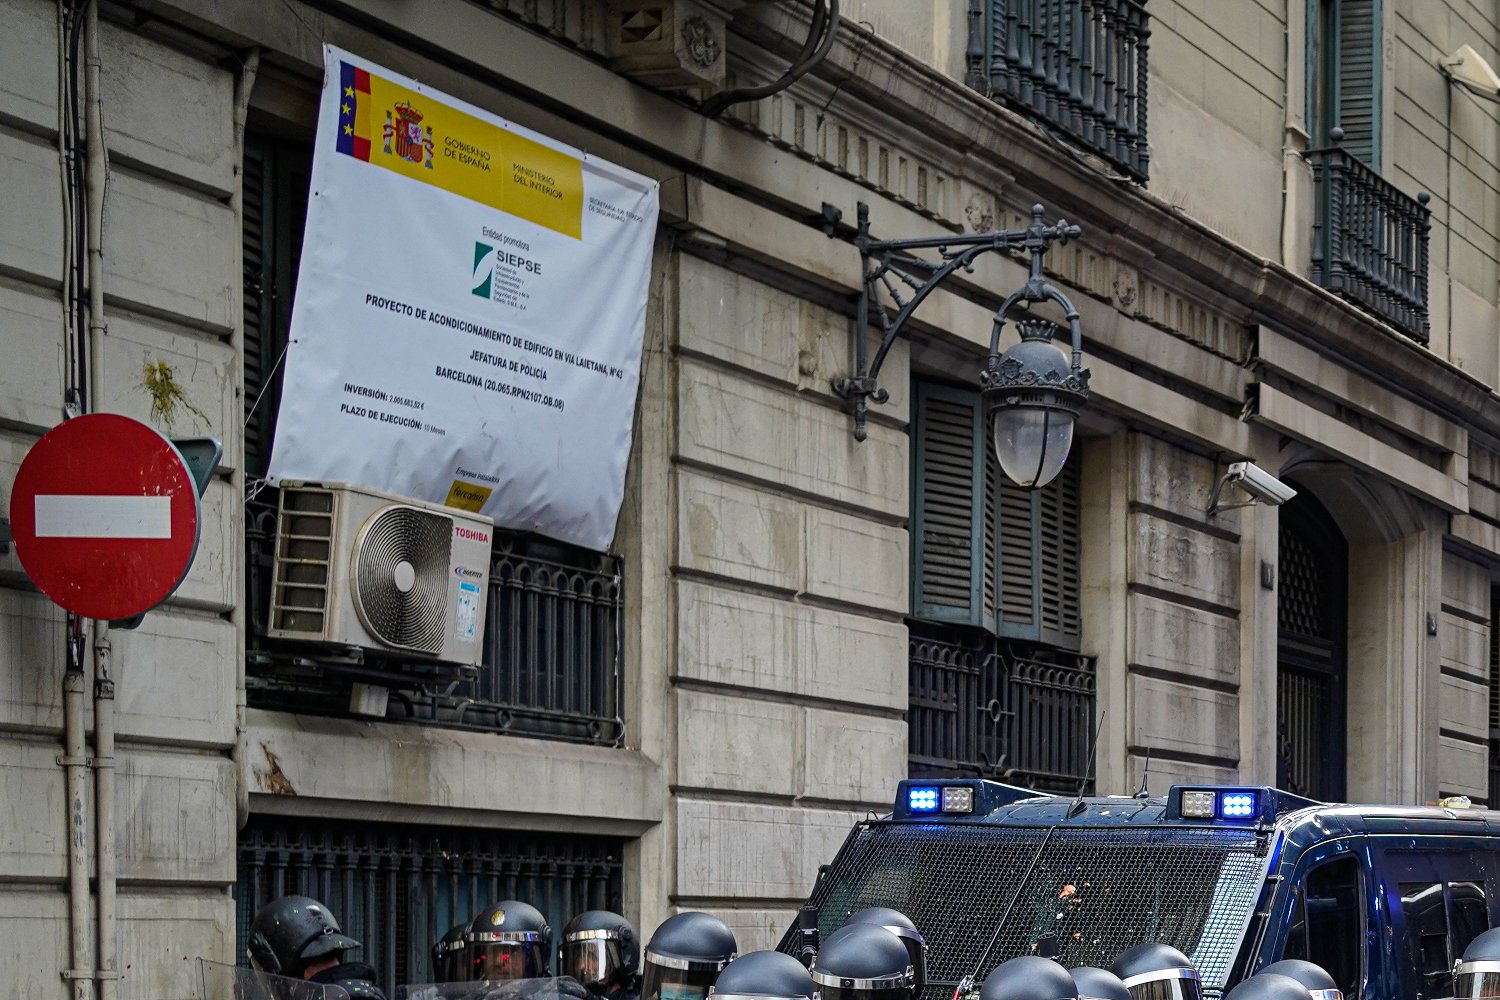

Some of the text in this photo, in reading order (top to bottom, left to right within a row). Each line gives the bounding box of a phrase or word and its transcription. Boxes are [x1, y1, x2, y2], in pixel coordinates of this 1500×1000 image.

[444, 149, 490, 173] DE ESPAÑA
[445, 136, 490, 161] GOBIERNO
[513, 163, 555, 186] MINISTERIO
[514, 175, 563, 200] DEL INTERIOR
[497, 250, 541, 275] SIEPSE
[366, 293, 413, 316] PROYECTO
[415, 308, 427, 320] DE
[429, 312, 511, 345] ACONDICIONAMIENTO
[513, 336, 522, 349] DE
[524, 340, 554, 358] EDIFICIO
[554, 349, 563, 361] EN
[565, 352, 575, 365] VIA
[576, 357, 608, 376] LAIETANA,
[436, 366, 483, 387] BARCELONA
[470, 349, 547, 381] JEFATURA DE POLICÍA
[344, 383, 388, 401] INVERSIÓN:
[341, 403, 366, 417] PLAZO
[368, 410, 378, 420] DE
[380, 412, 422, 430] EJECUCIÓN:
[455, 527, 489, 543] TOSHIBA
